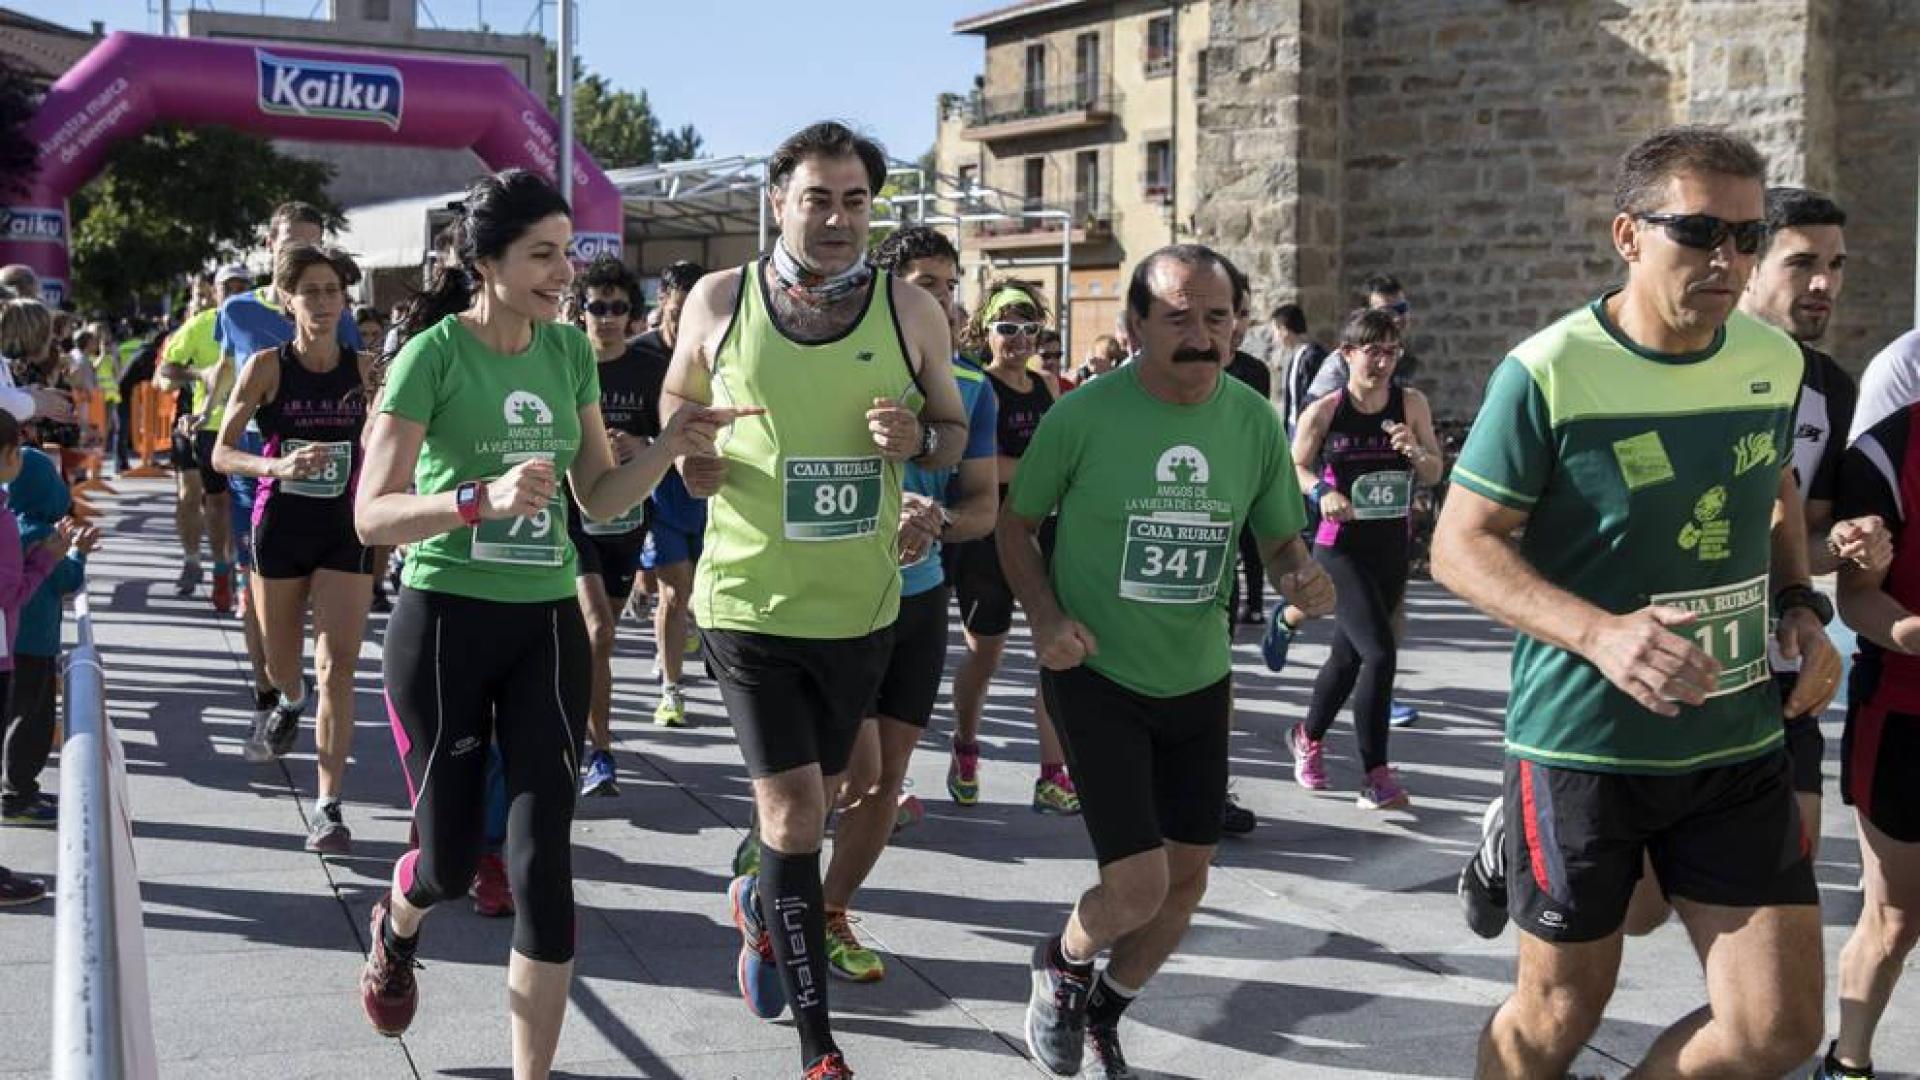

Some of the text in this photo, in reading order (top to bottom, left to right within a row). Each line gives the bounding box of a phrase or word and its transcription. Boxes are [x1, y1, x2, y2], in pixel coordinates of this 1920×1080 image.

[85, 77, 129, 116] marca
[272, 64, 389, 115] Kaiku
[61, 99, 130, 165] de siempre
[508, 427, 541, 439] AMIGOS
[475, 440, 490, 454] LA
[793, 461, 878, 476] CAJA RURAL
[815, 484, 857, 514] 80
[1125, 499, 1139, 511] LA
[1140, 499, 1174, 510] VUELTA
[1175, 499, 1191, 511] DEL
[1156, 485, 1208, 499] AMIGOS DE
[1368, 486, 1394, 504] 46
[508, 507, 552, 537] 79
[1137, 523, 1227, 541] CAJA RURAL
[1140, 546, 1208, 579] 341
[1714, 585, 1762, 611] RURAL
[1694, 619, 1739, 659] 11
